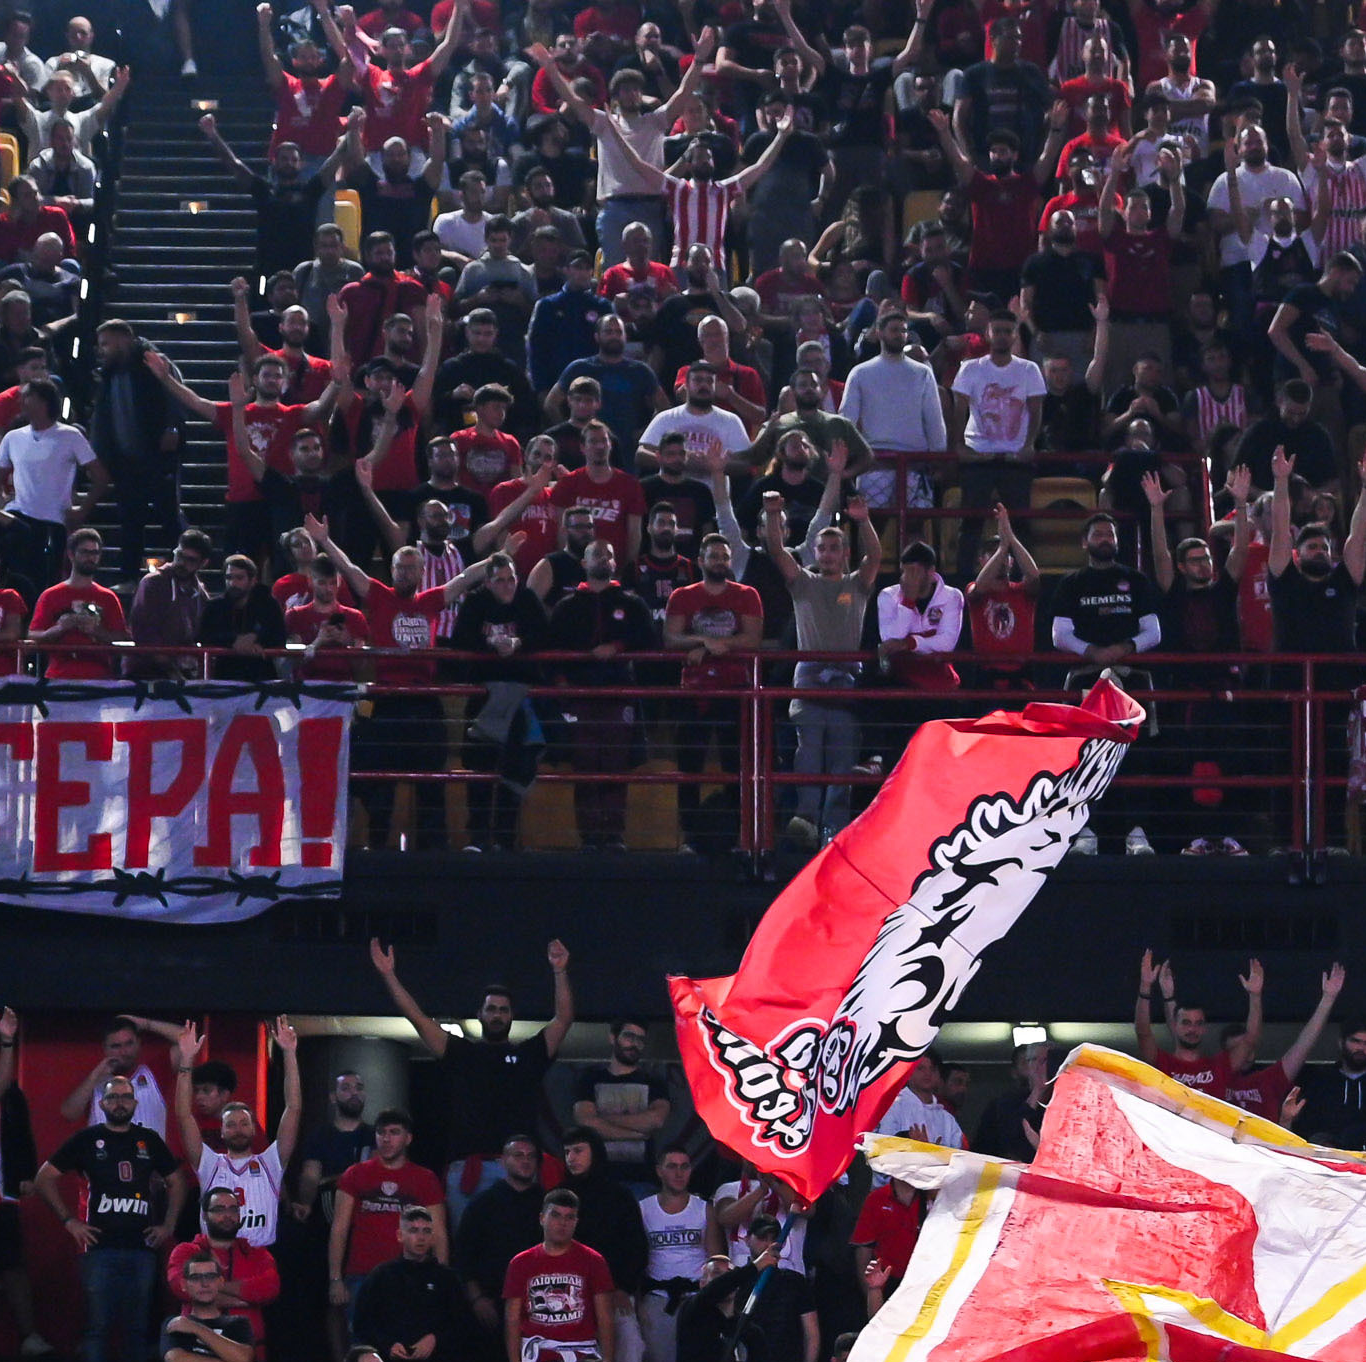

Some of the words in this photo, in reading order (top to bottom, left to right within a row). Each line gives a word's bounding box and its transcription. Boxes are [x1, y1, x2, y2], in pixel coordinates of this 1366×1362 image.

[1080, 594, 1132, 606] SIEMENS
[118, 1161, 132, 1182] 0
[97, 1193, 149, 1216] bwin
[649, 1229, 701, 1245] HOUSTON
